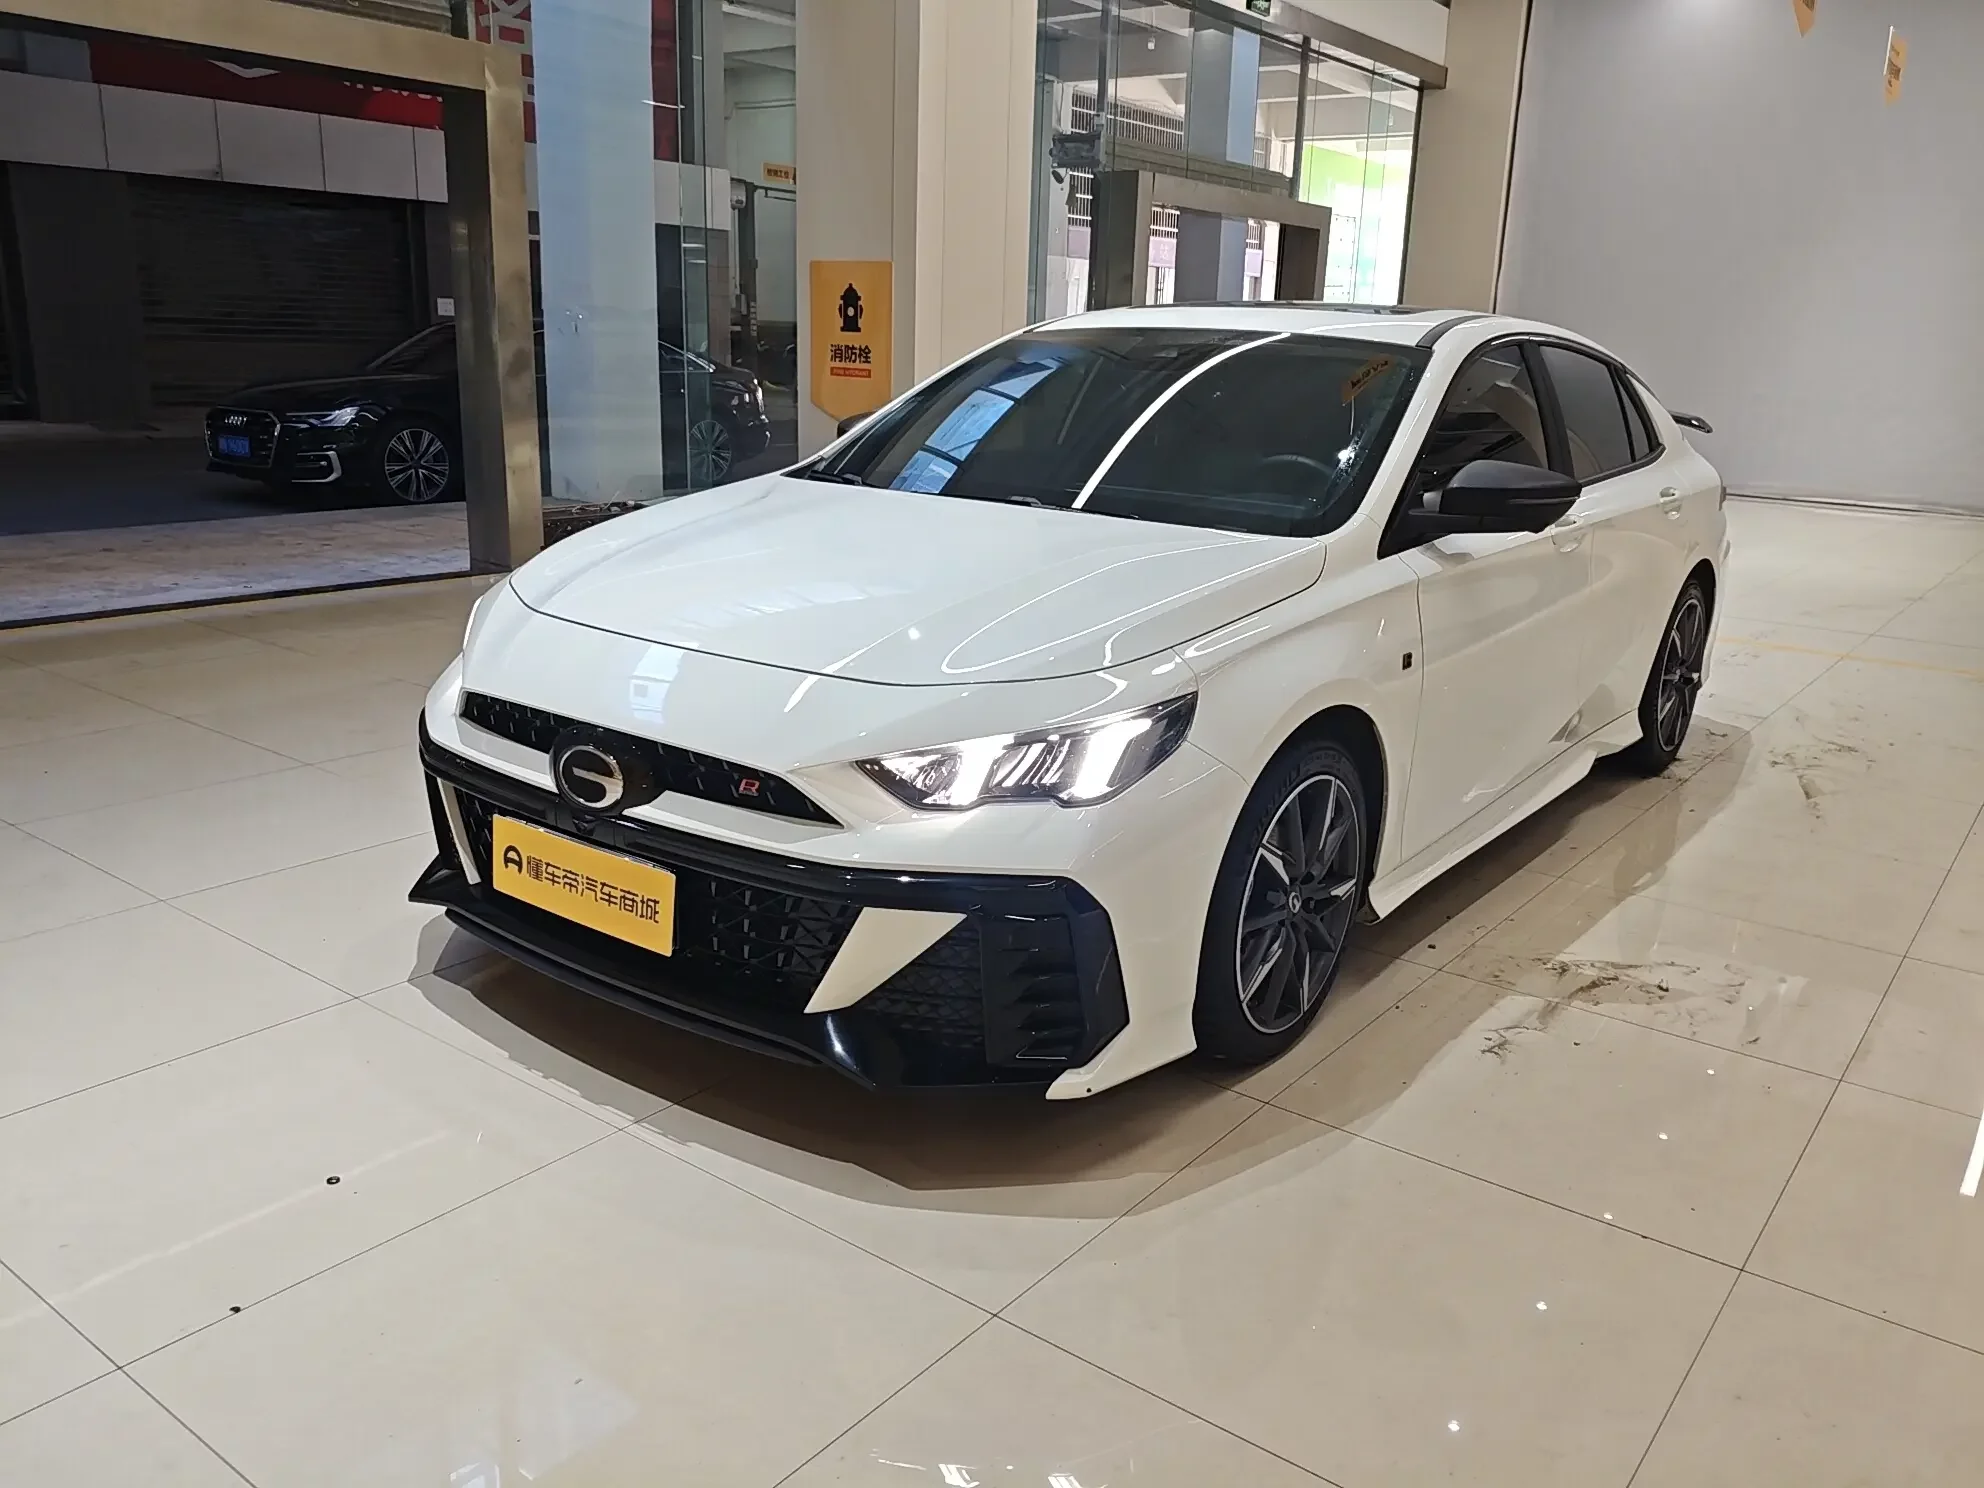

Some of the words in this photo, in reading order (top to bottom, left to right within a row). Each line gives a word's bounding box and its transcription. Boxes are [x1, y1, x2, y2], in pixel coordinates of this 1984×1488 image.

[830, 343, 872, 364] 消防栓
[526, 855, 660, 924] 懂车帝汽车商城
